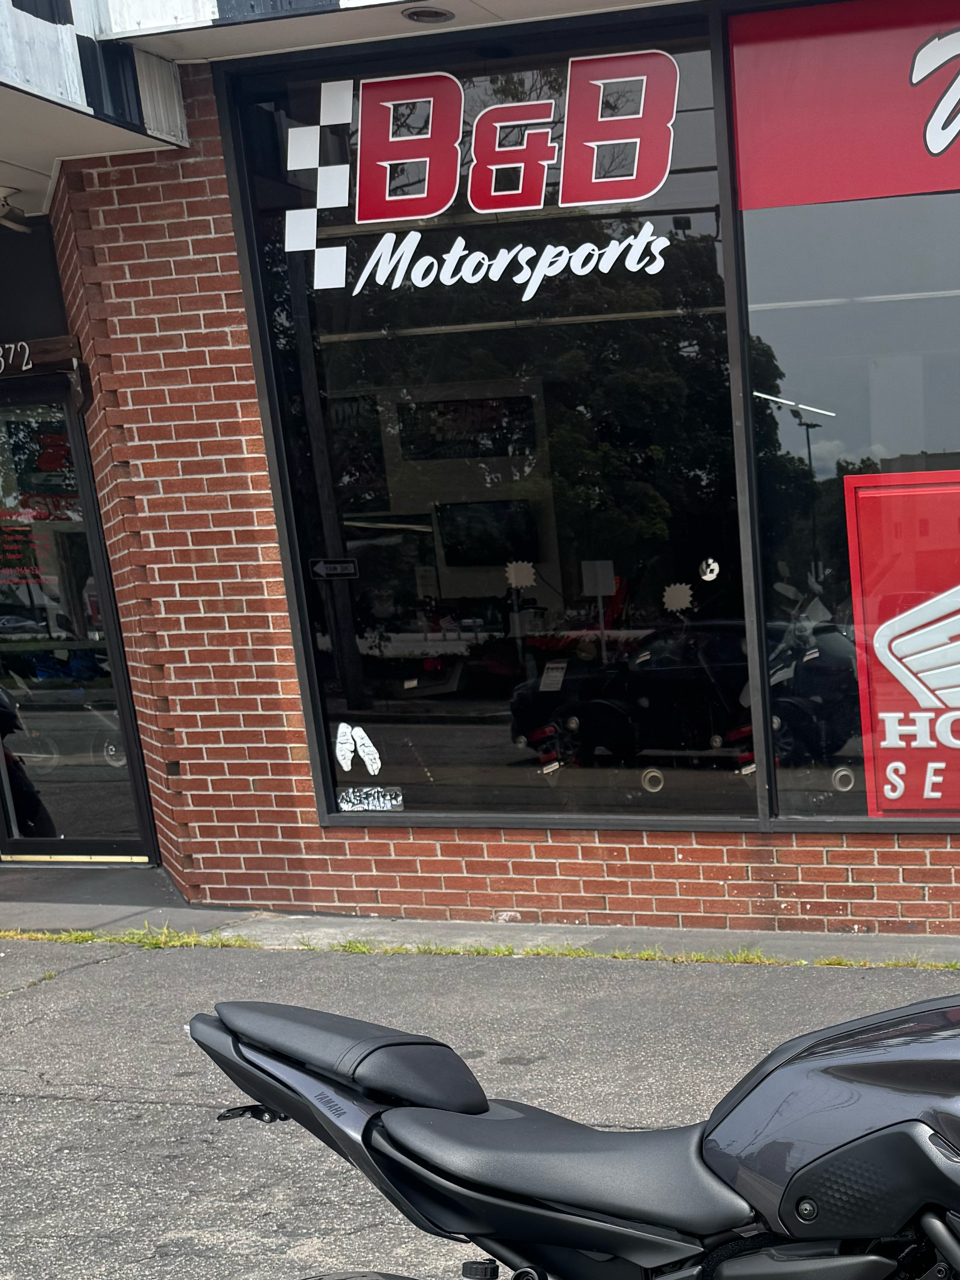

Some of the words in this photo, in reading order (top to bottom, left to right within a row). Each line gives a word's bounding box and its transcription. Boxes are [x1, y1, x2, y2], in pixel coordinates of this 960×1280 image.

[355, 50, 680, 224] B&B
[352, 221, 671, 302] Motorsports
[313, 1091, 347, 1119] YAMAHA
